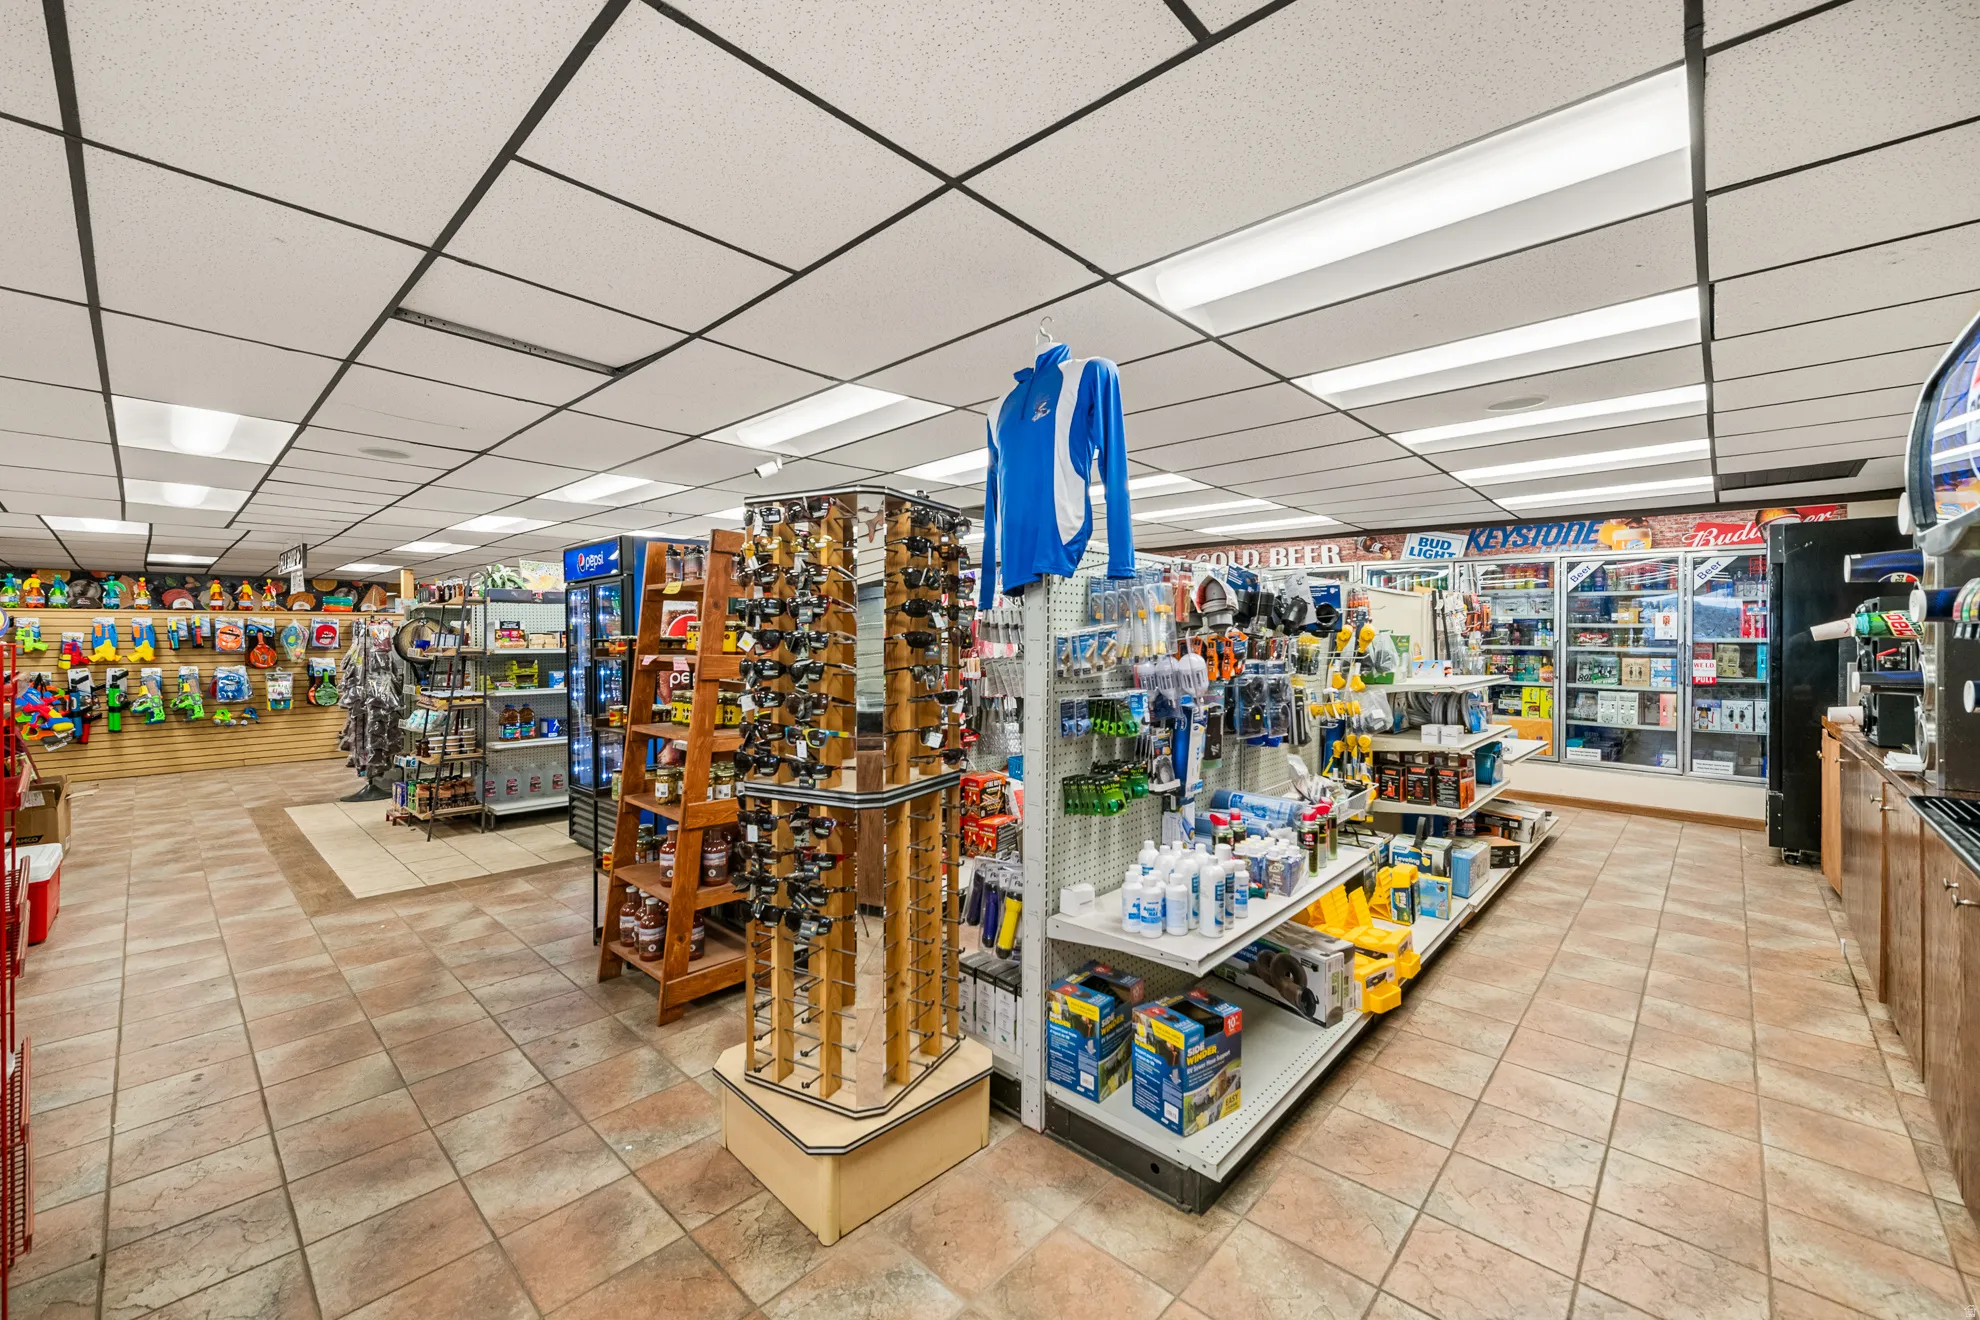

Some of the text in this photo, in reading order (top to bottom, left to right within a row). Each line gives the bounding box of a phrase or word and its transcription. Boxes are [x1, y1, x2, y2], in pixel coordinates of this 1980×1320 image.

[1418, 537, 1452, 551] BUD
[1467, 520, 1605, 552] KEYSTONE
[585, 551, 604, 571] pepsi
[1196, 544, 1342, 568] COLD BEER
[1409, 547, 1456, 559] LIGHT
[1569, 564, 1591, 584] Beer
[1696, 560, 1723, 581] Beer
[1394, 855, 1420, 866] Leveling
[1186, 1045, 1217, 1066] WINDER
[1187, 1041, 1205, 1057] SIDE
[1225, 1093, 1239, 1106] EASY
